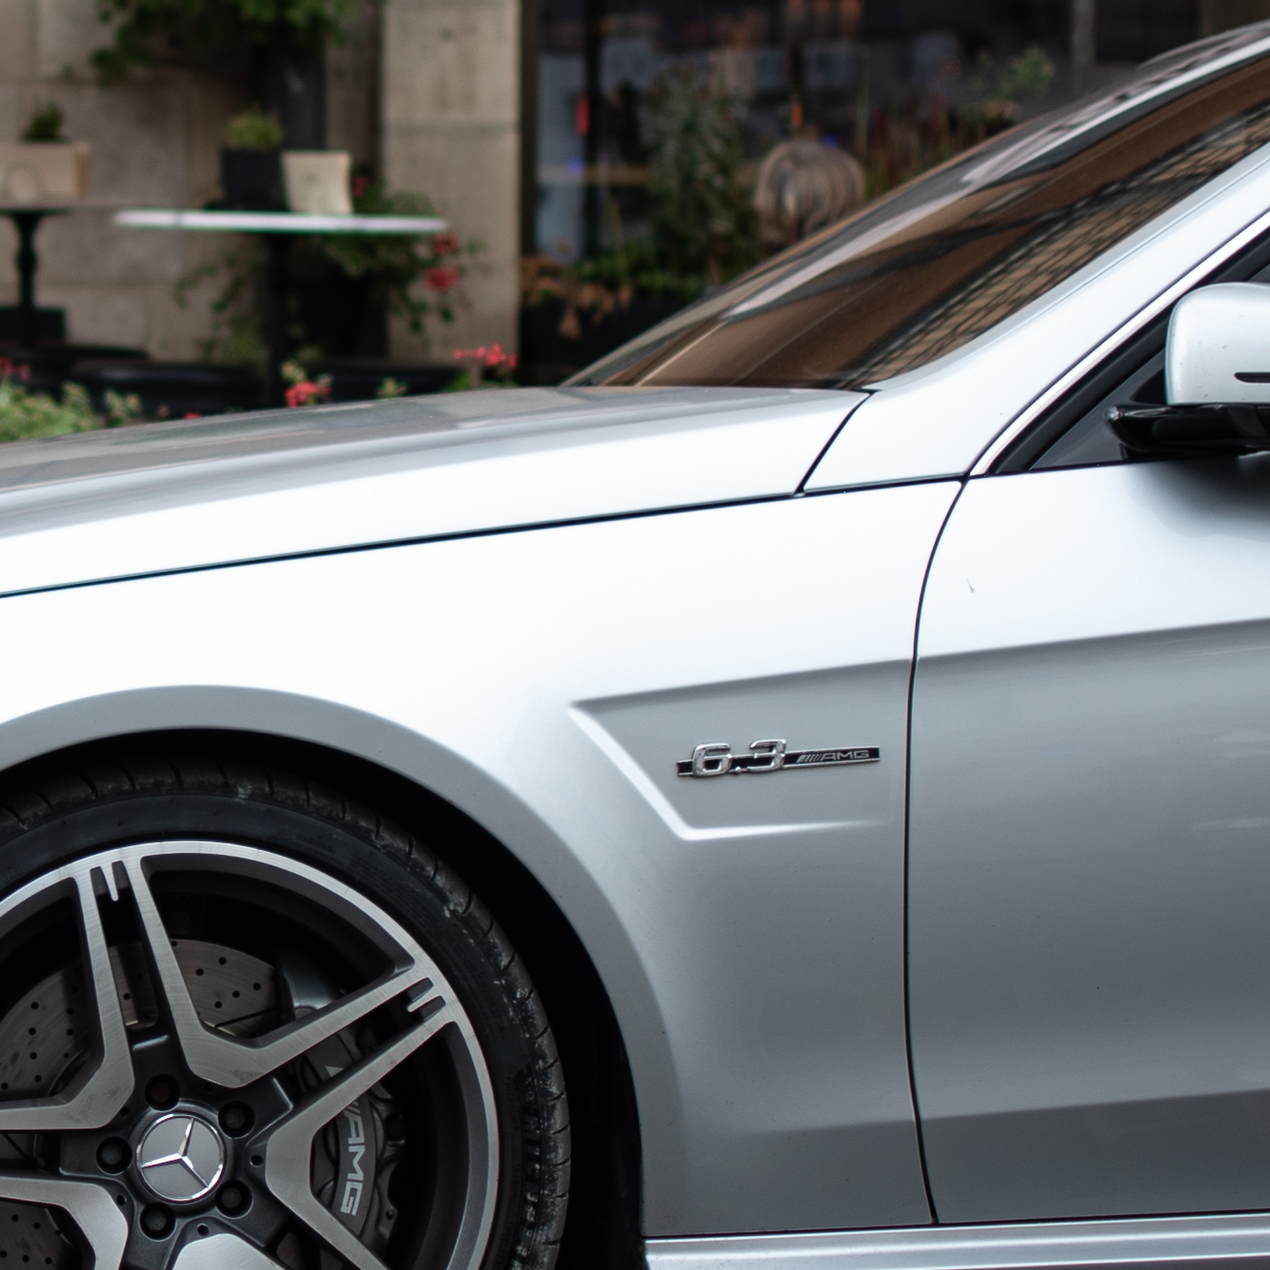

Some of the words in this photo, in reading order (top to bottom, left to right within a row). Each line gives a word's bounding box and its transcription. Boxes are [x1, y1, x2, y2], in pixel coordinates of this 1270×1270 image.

[692, 738, 787, 777] 6.3
[822, 749, 870, 762] AMG
[341, 1115, 366, 1216] AMG
